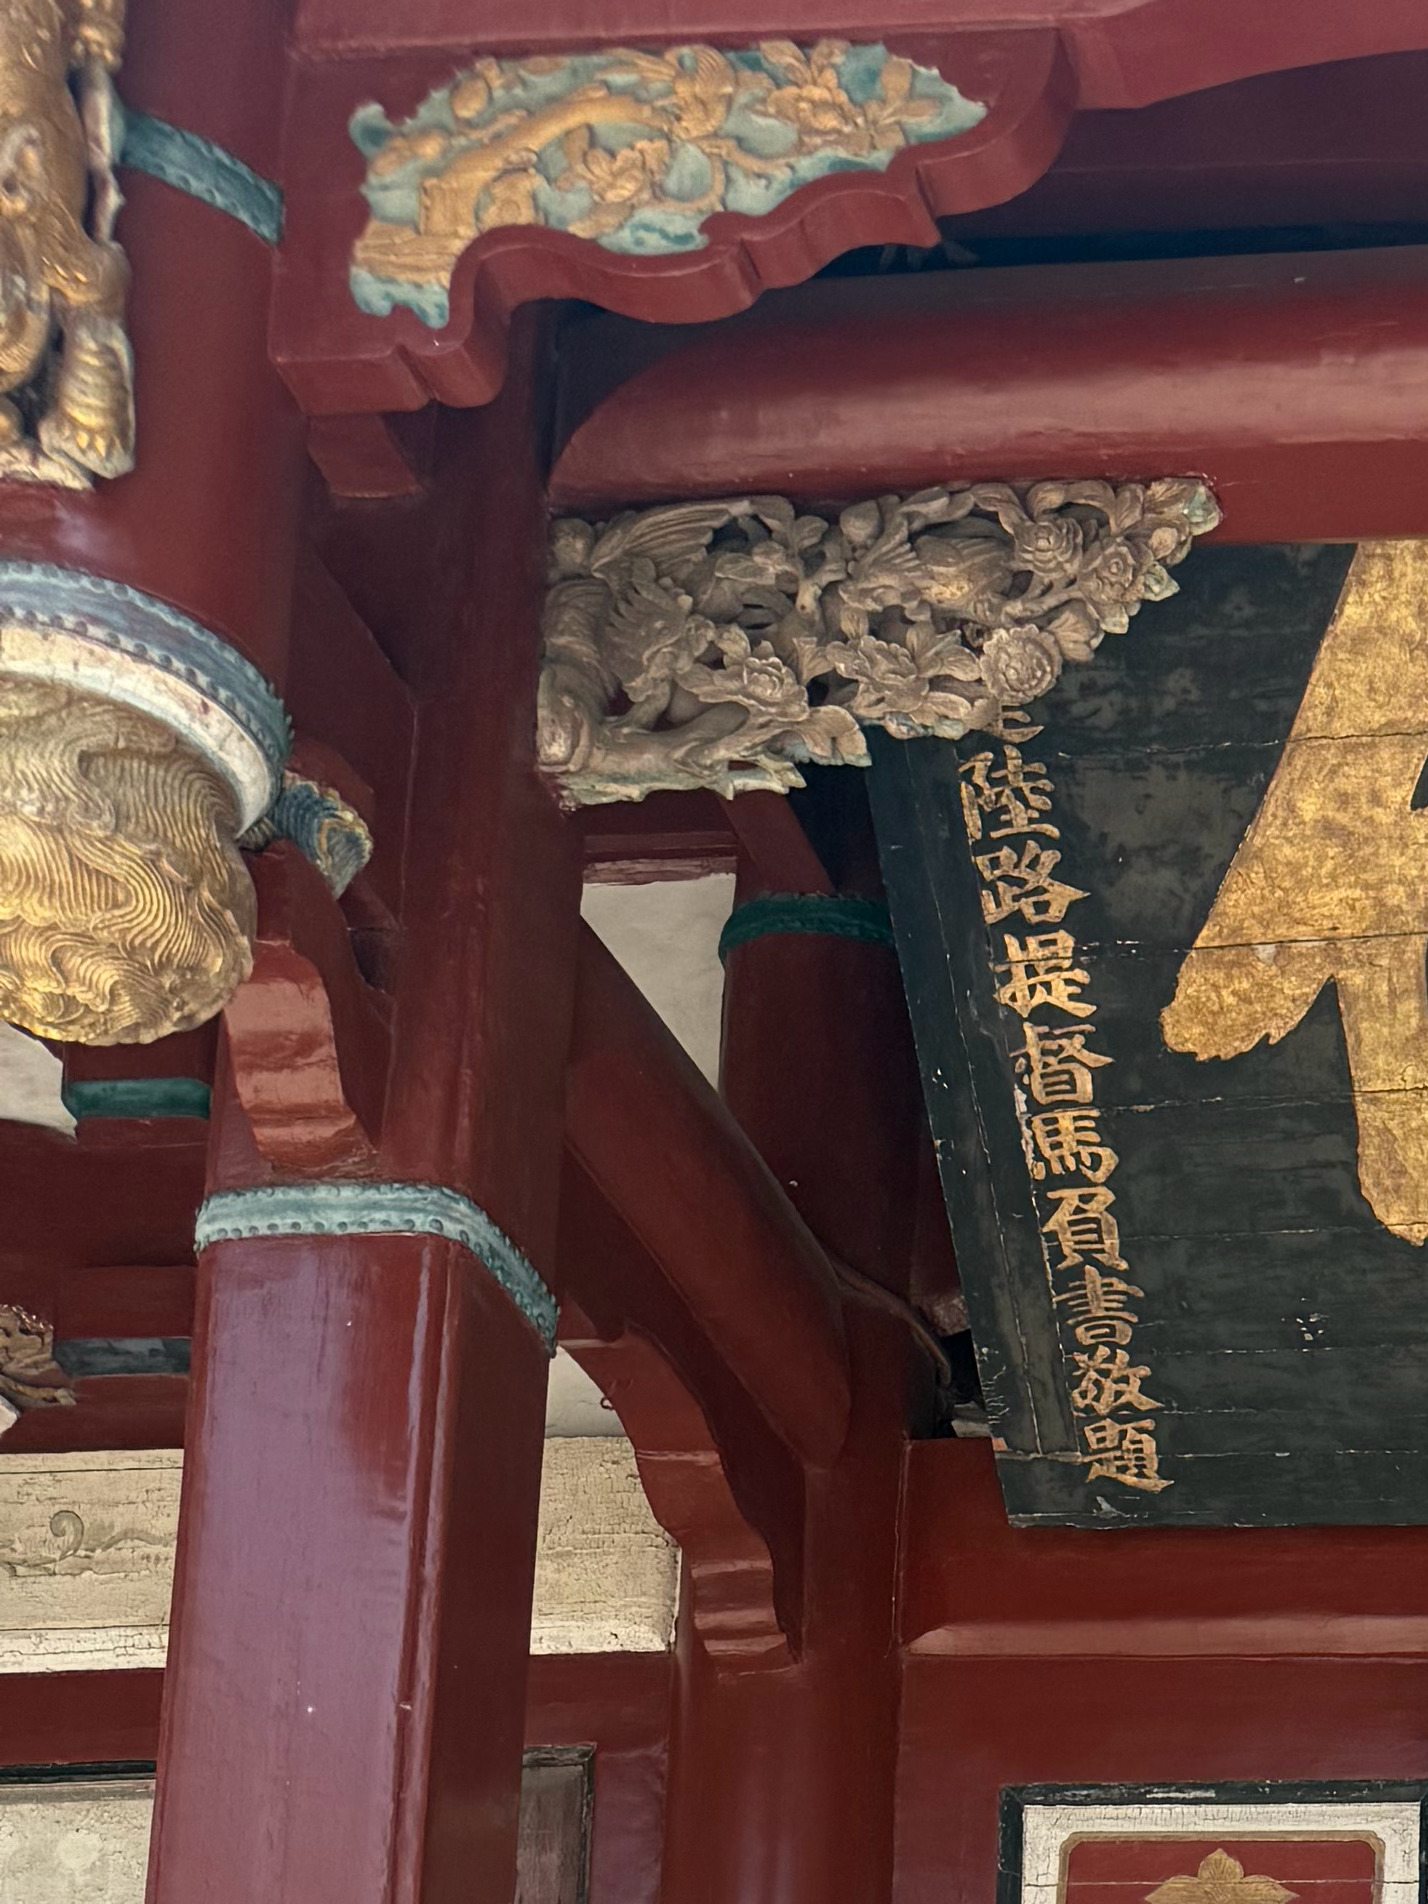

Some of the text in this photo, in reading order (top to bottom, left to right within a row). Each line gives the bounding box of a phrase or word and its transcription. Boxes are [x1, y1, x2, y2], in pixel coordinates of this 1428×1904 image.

[958, 703, 1174, 1493] 陸路提督馬負書敬題
